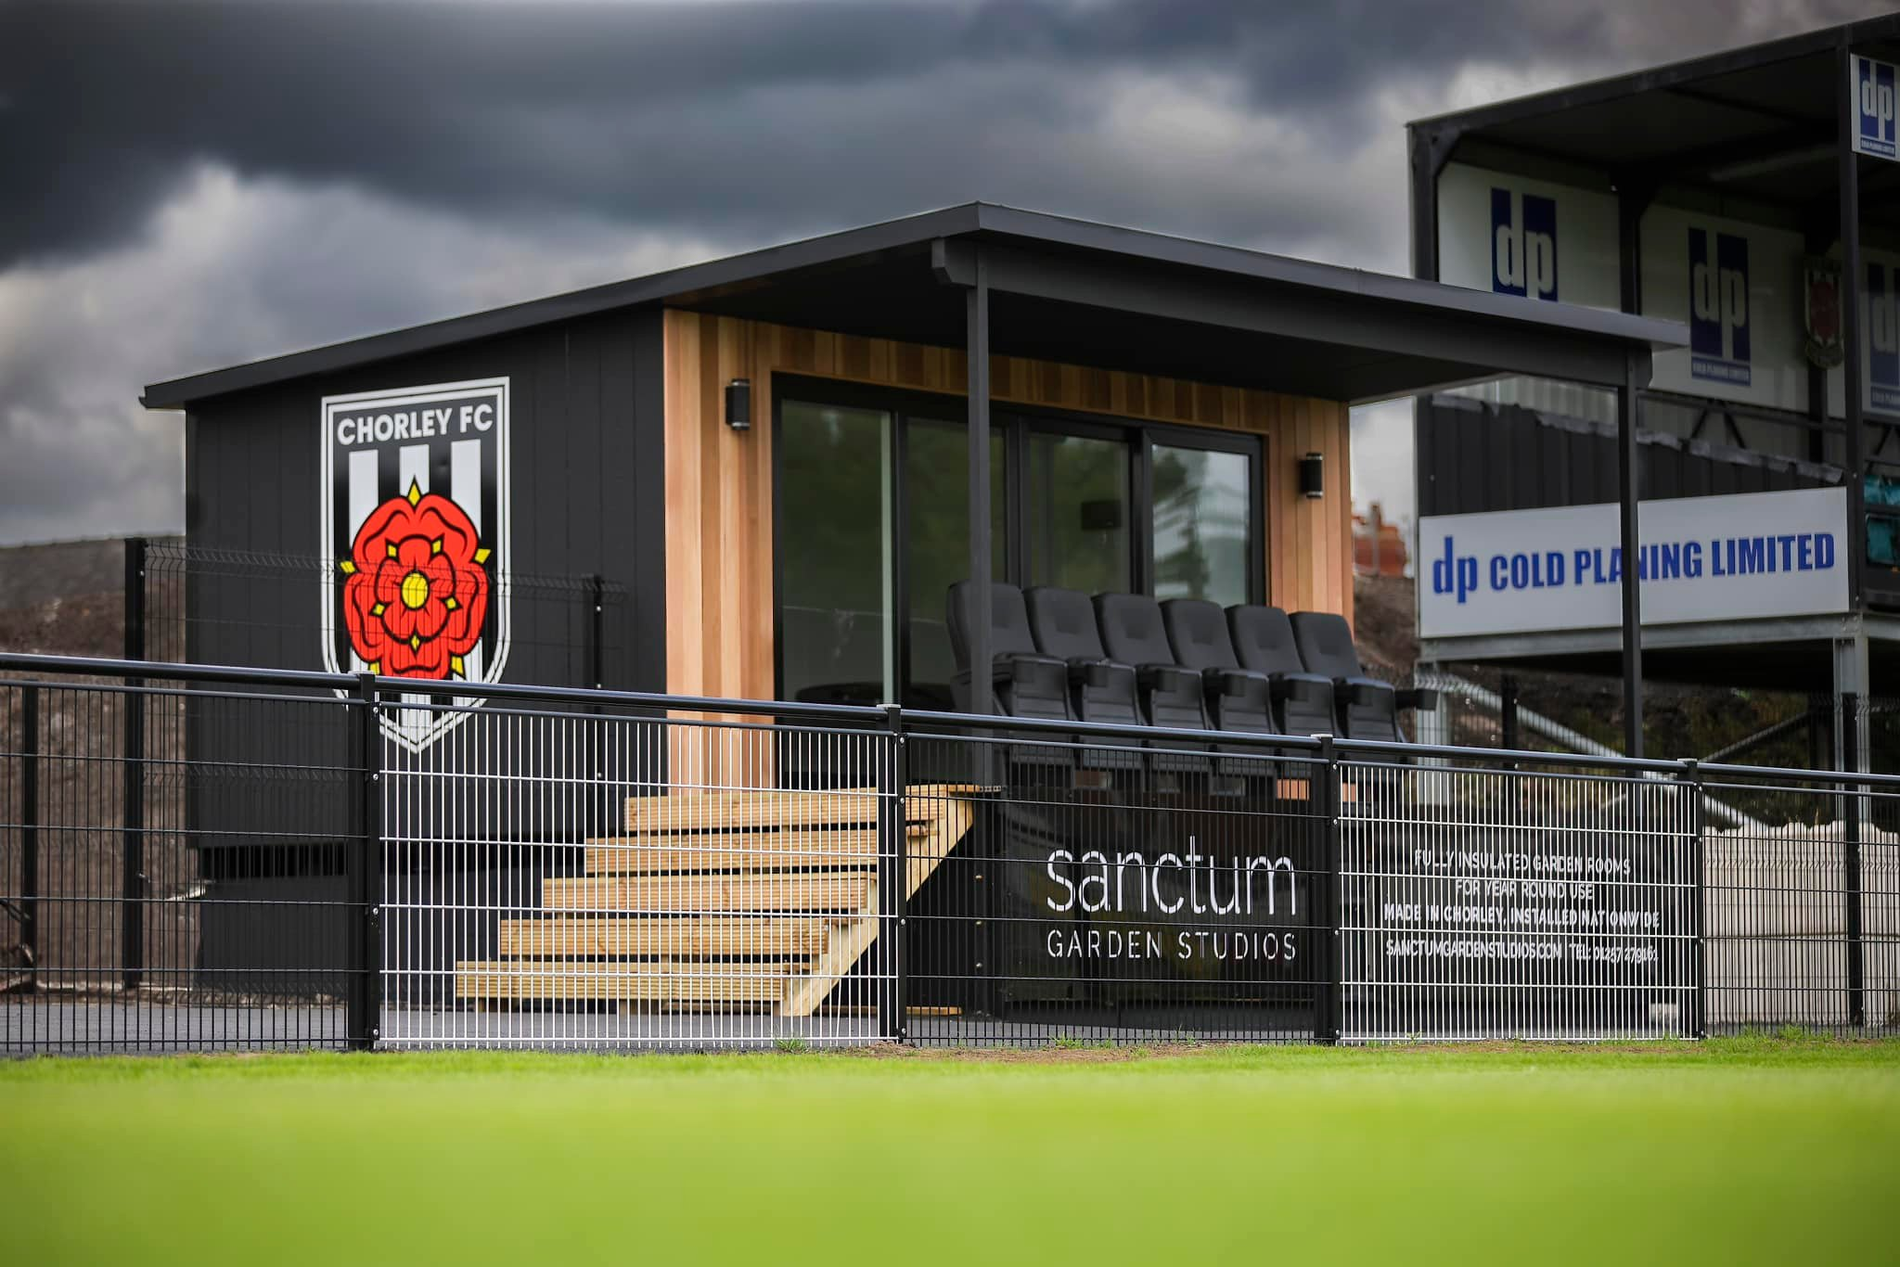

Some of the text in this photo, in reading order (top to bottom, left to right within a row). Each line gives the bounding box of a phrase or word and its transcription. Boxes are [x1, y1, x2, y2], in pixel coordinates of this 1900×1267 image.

[1861, 60, 1893, 141] dp
[1496, 190, 1554, 298] dp
[1694, 229, 1746, 359] dp
[337, 404, 493, 445] CHORLEY FC
[1433, 536, 1478, 603] dp
[1490, 551, 1565, 590] COLD
[1711, 533, 1835, 576] LIMITED
[1047, 835, 1296, 915] sanctum
[1458, 851, 1528, 871] INSULATED
[1532, 854, 1583, 874] GARDEN
[1587, 857, 1631, 875] ROOMS
[1455, 879, 1593, 900] FOR YEAR ROUND USE
[1384, 903, 1660, 929] MADE IN CHORLEY, INSTALLED NATONWDE
[1047, 929, 1296, 960] GARDEN STUDIOS
[1386, 939, 1562, 960] SANCTUMGARDENSTUDIOSCOM
